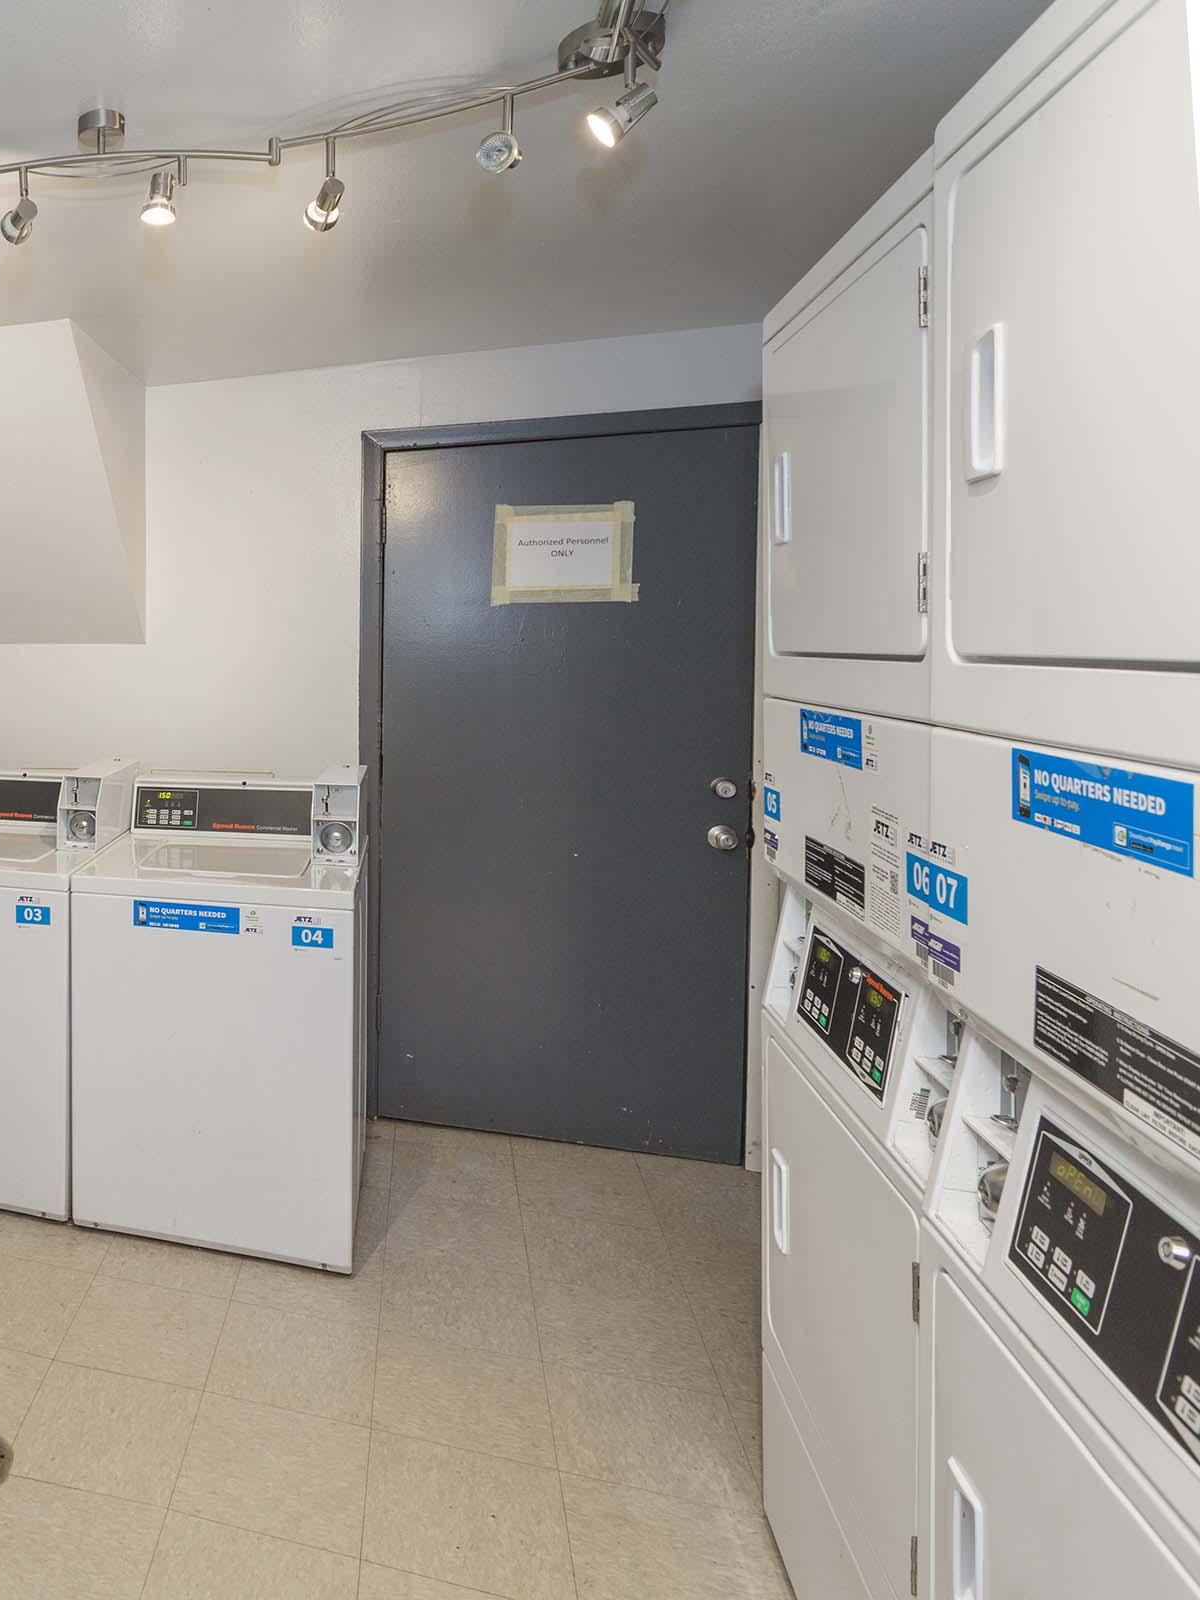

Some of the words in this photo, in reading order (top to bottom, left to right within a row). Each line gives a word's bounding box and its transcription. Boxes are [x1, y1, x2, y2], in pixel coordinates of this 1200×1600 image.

[517, 537, 564, 547] Authorized
[566, 536, 609, 545] Personnel
[550, 550, 574, 558] ONLY
[808, 719, 815, 730] NO
[815, 721, 836, 735] QUARTERS
[836, 724, 854, 739] NEEDED
[1033, 768, 1050, 787] NO
[1050, 772, 1111, 803] QUARTERS
[1112, 786, 1166, 816] NEEDED
[766, 791, 777, 814] 05
[873, 819, 890, 839] JETZ
[907, 832, 922, 848] JETZ
[929, 840, 947, 858] JETZ
[913, 861, 930, 896] 06
[935, 872, 958, 909] 07
[23, 907, 43, 922] 03
[149, 906, 160, 914] NO
[160, 907, 198, 917] QUARTERS
[198, 910, 227, 919] NEEDED
[294, 915, 313, 923] JETZ
[300, 928, 324, 944] 04
